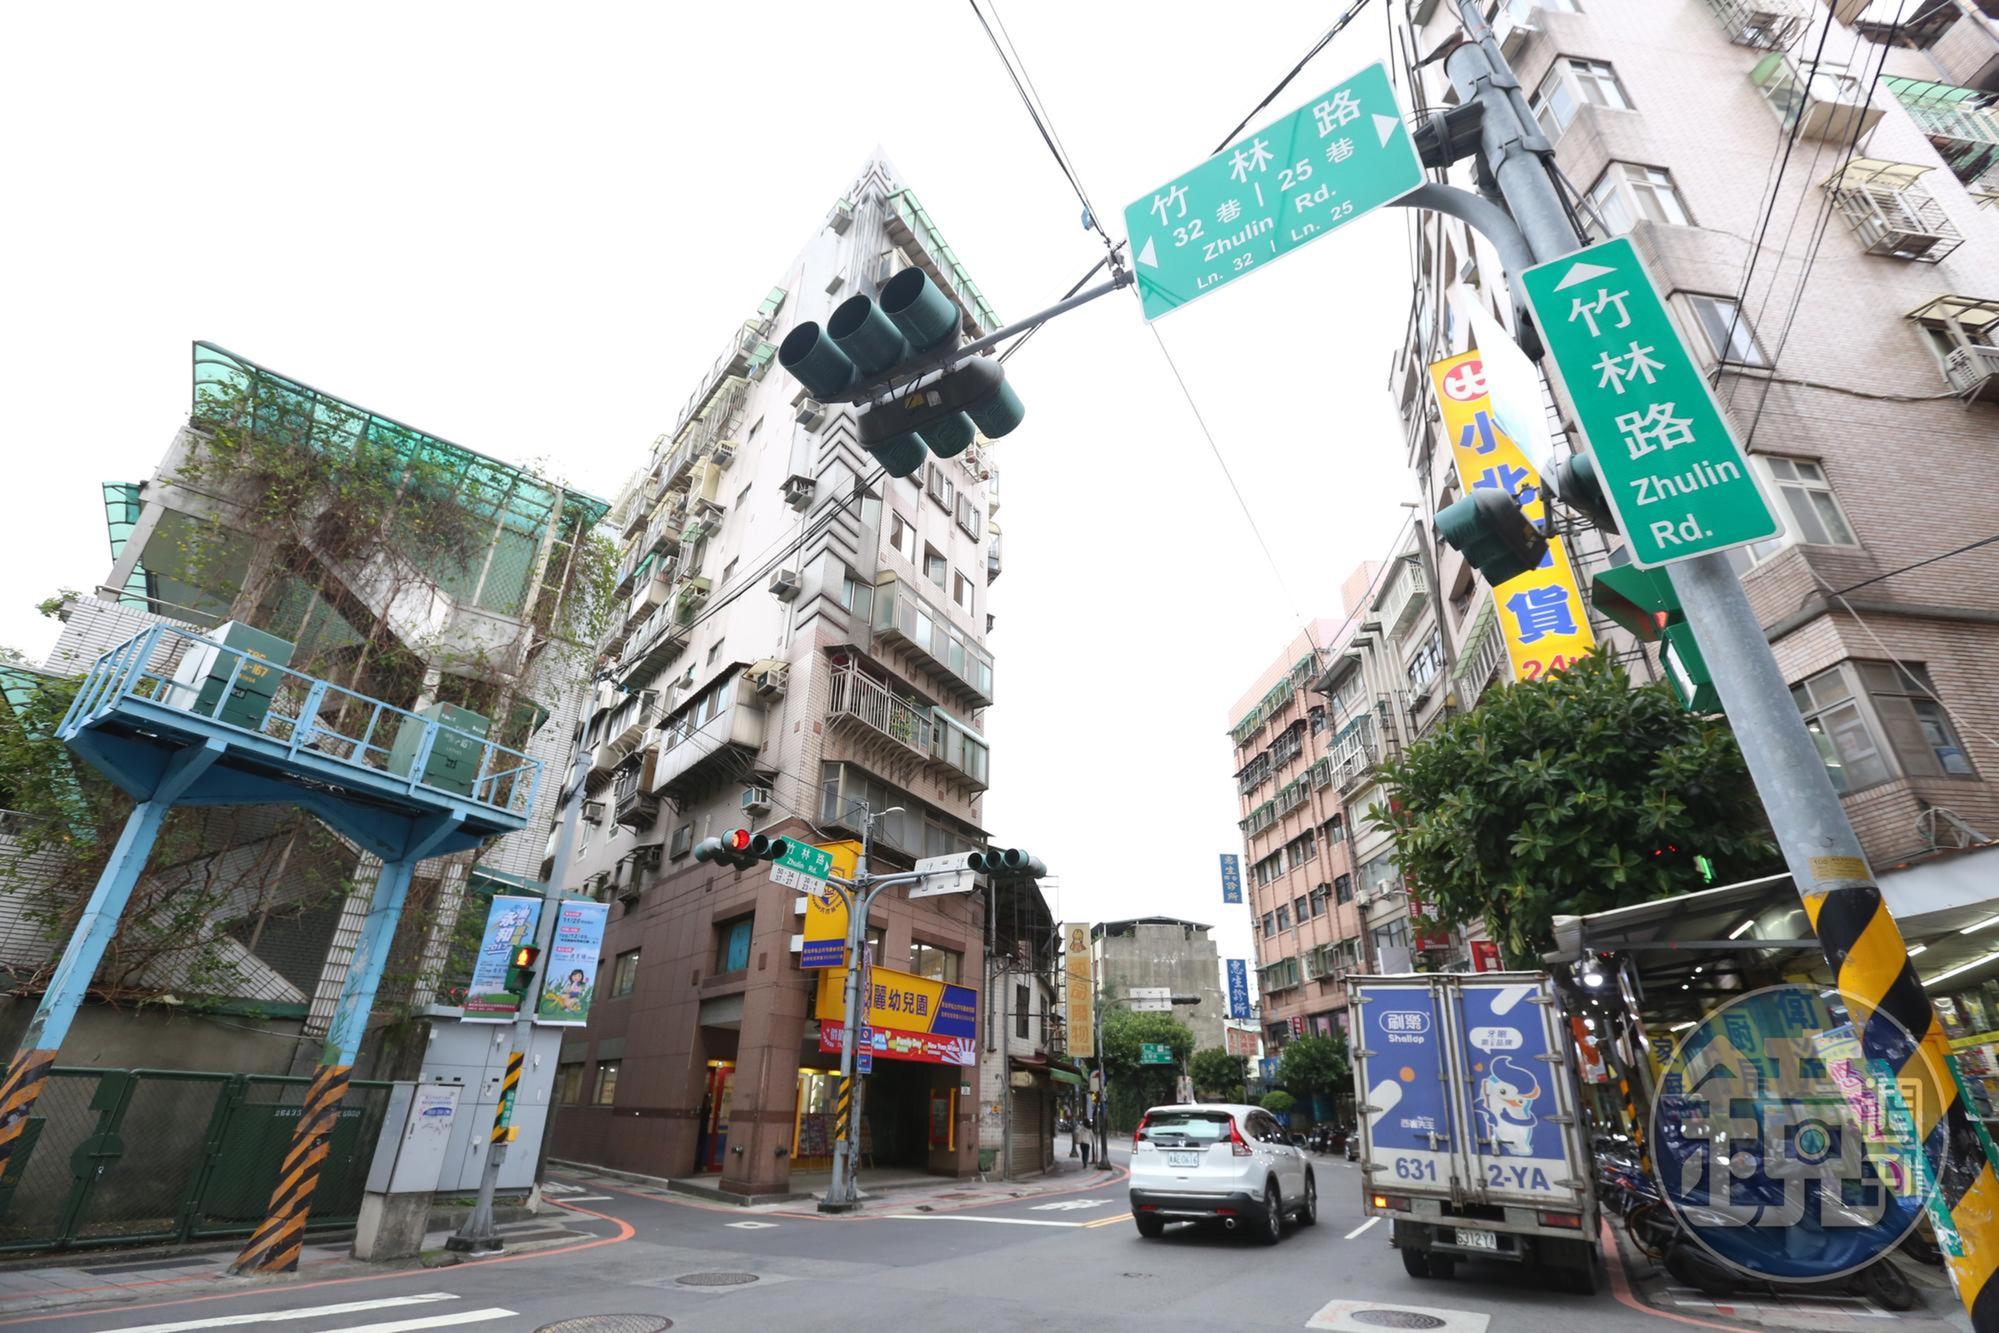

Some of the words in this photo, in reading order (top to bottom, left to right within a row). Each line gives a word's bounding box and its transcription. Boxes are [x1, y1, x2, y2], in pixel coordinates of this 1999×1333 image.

[1150, 89, 1361, 226] 竹林路
[1197, 272, 1223, 290] Ln.
[1232, 252, 1254, 271] 32
[1290, 223, 1320, 242] Ln.
[1330, 200, 1354, 222] 25
[1202, 217, 1275, 262] Zhulin
[1295, 183, 1337, 213] Rd.
[1567, 288, 1696, 460] 竹林路
[1629, 459, 1741, 506] Zhulin
[1459, 410, 1579, 645] 小北貨
[1650, 513, 1713, 549] Rd.
[1388, 1034, 1425, 1045] Shallop
[1395, 1158, 1436, 1181] 631
[1487, 1164, 1551, 1191] 2-YA
